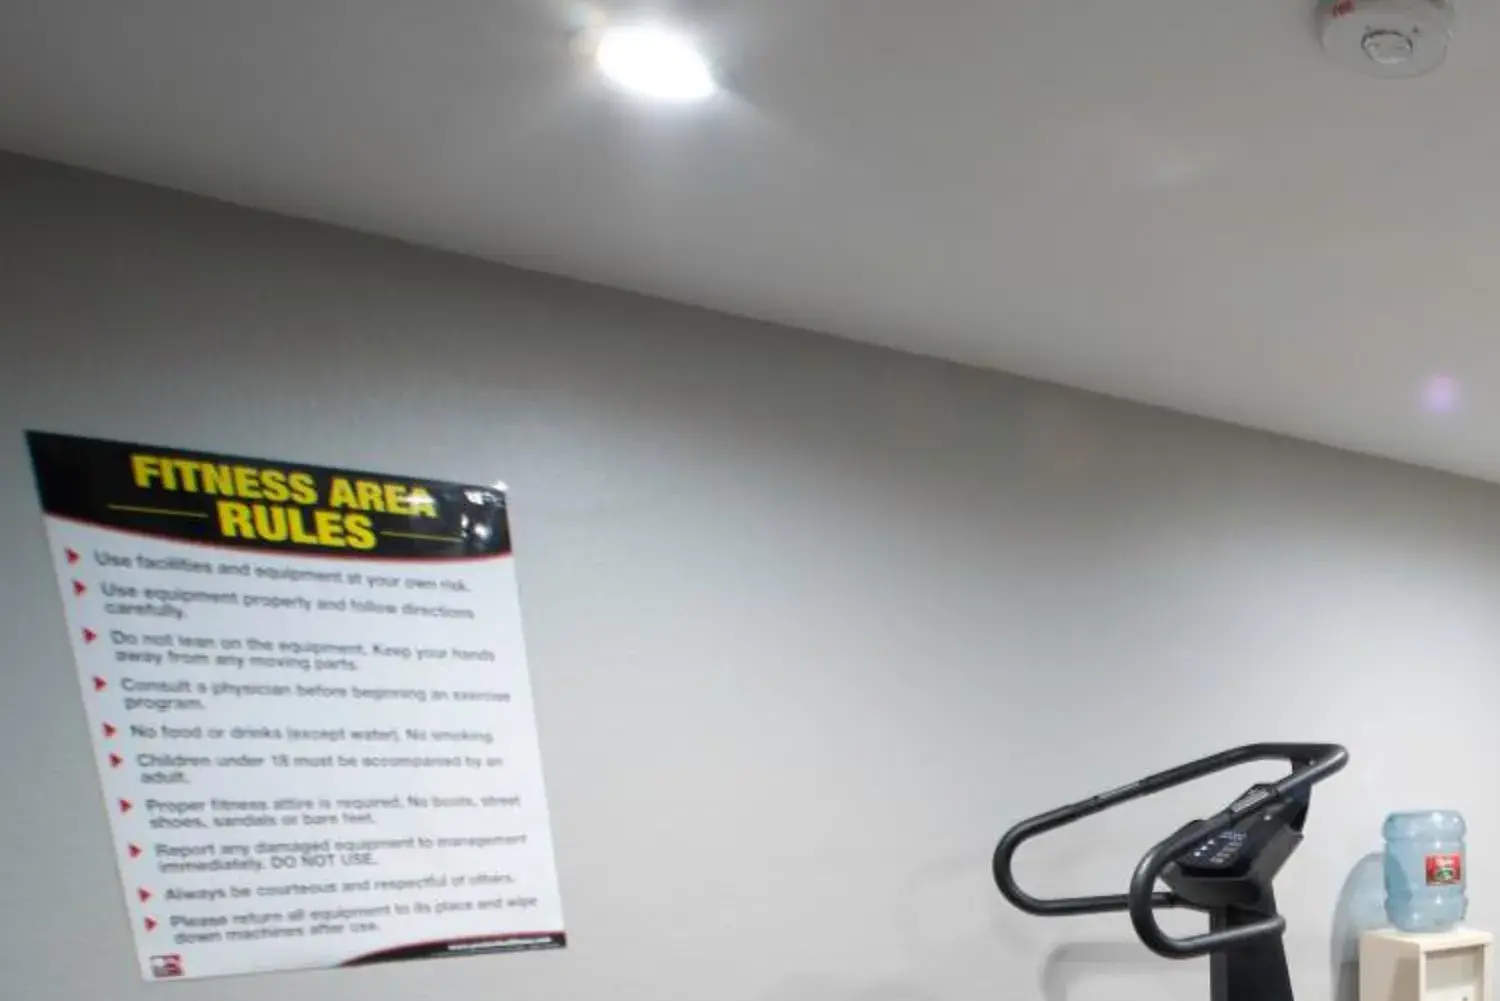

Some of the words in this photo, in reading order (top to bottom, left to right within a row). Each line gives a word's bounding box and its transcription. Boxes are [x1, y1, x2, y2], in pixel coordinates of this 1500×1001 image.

[131, 454, 318, 504] FITNESS
[330, 476, 438, 518] AREA
[217, 500, 376, 549] RULES
[94, 550, 132, 567] Use
[218, 564, 251, 576] and
[254, 566, 342, 584] equipment
[347, 573, 362, 585] at
[366, 576, 399, 589] your
[404, 578, 437, 589] own
[100, 581, 137, 597] Use
[143, 588, 238, 605] equipment
[317, 599, 347, 612] and
[110, 629, 137, 645] Do
[141, 633, 174, 646] not
[220, 639, 242, 649] on
[246, 637, 273, 651] the
[373, 644, 412, 659] Keep
[416, 648, 448, 661] your
[452, 648, 495, 663] hands
[115, 651, 162, 666] away
[167, 649, 209, 664] from
[215, 655, 244, 669] any
[249, 656, 311, 671] moving
[197, 683, 206, 693] a
[295, 684, 347, 698] before
[431, 690, 448, 701] an
[130, 724, 157, 739] No
[161, 724, 202, 739] food
[207, 728, 224, 739] or
[229, 726, 282, 739] drinks
[405, 727, 427, 741] No
[137, 753, 211, 767] Children
[215, 754, 264, 767] under
[293, 755, 332, 767] must
[337, 756, 358, 767] be
[465, 756, 482, 769] by
[486, 758, 504, 767] an
[145, 799, 205, 815] Proper
[318, 798, 331, 810] is
[407, 793, 428, 808] No
[280, 816, 298, 826] or
[154, 842, 215, 857] Report
[220, 845, 250, 857] any
[254, 840, 330, 854] damaged
[334, 837, 415, 851] equipment
[418, 837, 433, 848] to
[270, 855, 297, 870] DO
[302, 853, 336, 868] NOT
[165, 887, 226, 901] Always
[229, 885, 252, 898] be
[342, 880, 370, 892] and
[451, 874, 466, 887] of
[169, 915, 228, 927] Please
[232, 912, 283, 924] return
[309, 906, 390, 921] equipment
[394, 903, 410, 915] to
[477, 897, 503, 909] and
[174, 931, 222, 945] down
[310, 923, 345, 935] after
